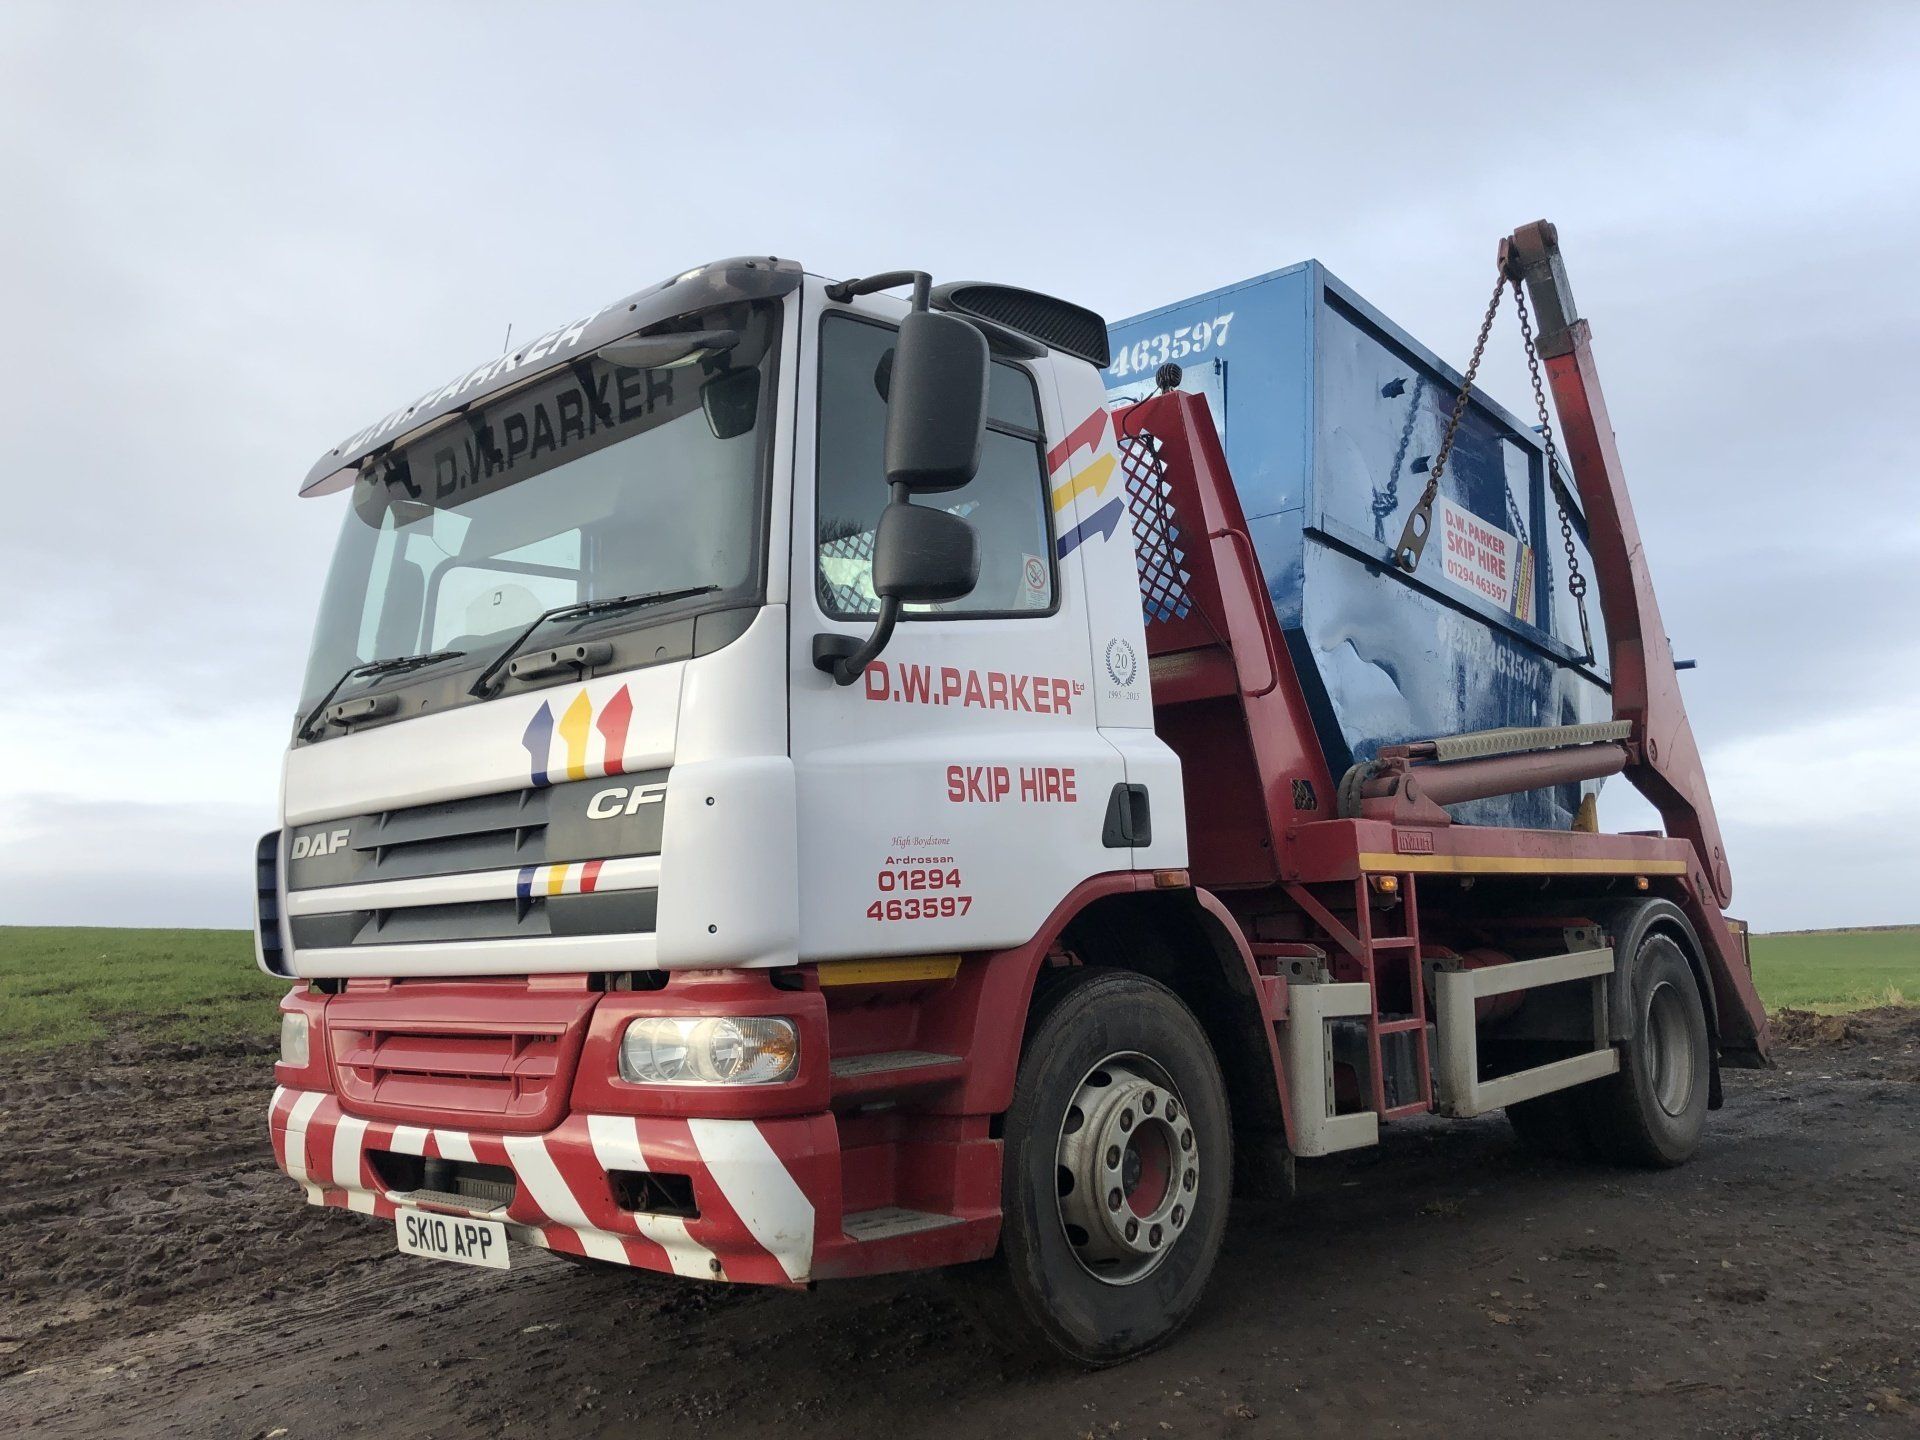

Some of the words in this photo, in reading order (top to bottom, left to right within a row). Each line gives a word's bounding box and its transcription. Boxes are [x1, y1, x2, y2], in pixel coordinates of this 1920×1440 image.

[1109, 312, 1235, 377] 463597
[1445, 508, 1467, 535] D.W.
[1469, 522, 1505, 556] PARKER
[1447, 530, 1475, 561] SKIP
[1478, 550, 1506, 581] HIRE
[1447, 559, 1474, 585] 01294
[1476, 574, 1507, 603] 463597
[1115, 653, 1128, 669] 20
[1072, 680, 1085, 695] Ltd
[947, 765, 1010, 803] SKIP
[1019, 767, 1077, 803] HIRE
[586, 783, 667, 820] CF
[291, 829, 350, 860] DAF
[891, 835, 911, 849] High
[885, 856, 954, 865] Ardrossan
[878, 868, 961, 892] 01294
[866, 896, 973, 921] 463597
[405, 1215, 448, 1253] SK10
[454, 1223, 492, 1259] APP
